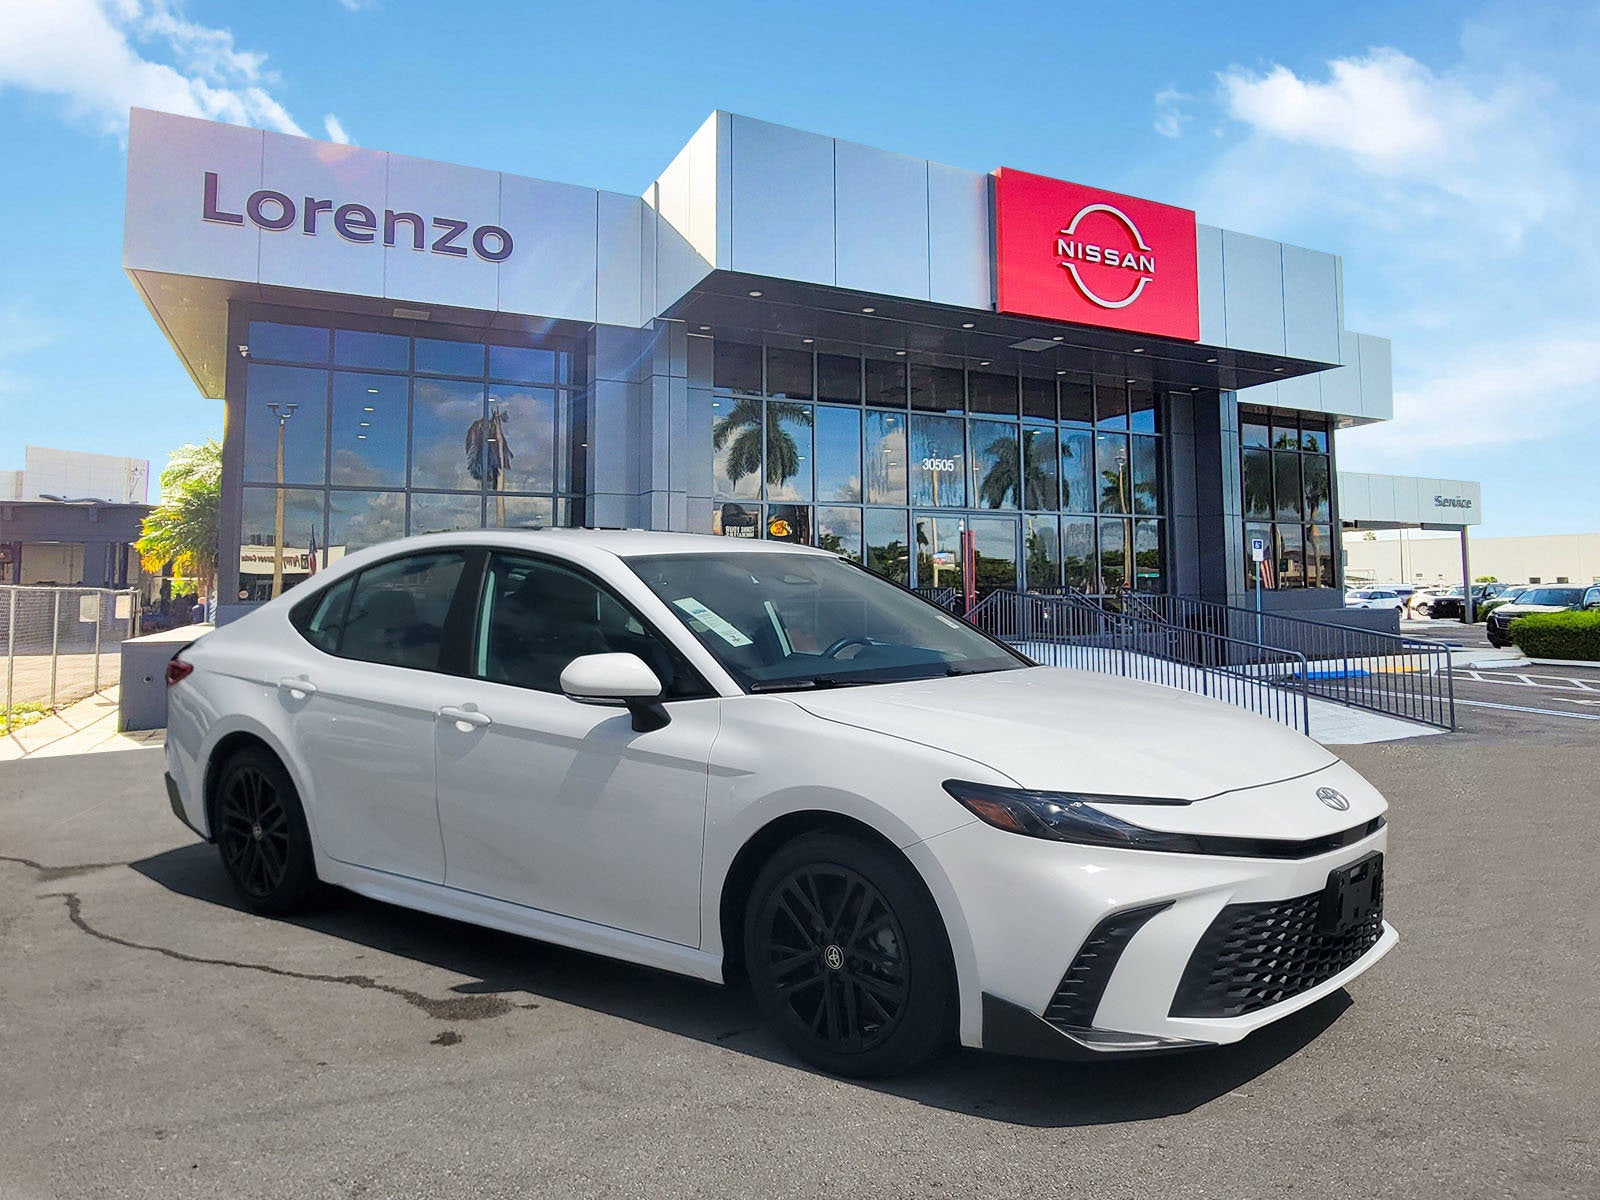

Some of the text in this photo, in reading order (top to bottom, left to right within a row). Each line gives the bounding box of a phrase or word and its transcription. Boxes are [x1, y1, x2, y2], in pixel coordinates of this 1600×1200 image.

[202, 171, 515, 263] Lorenzo
[1057, 238, 1155, 273] NISSAN
[922, 458, 955, 472] 30505
[1434, 495, 1472, 509] Service
